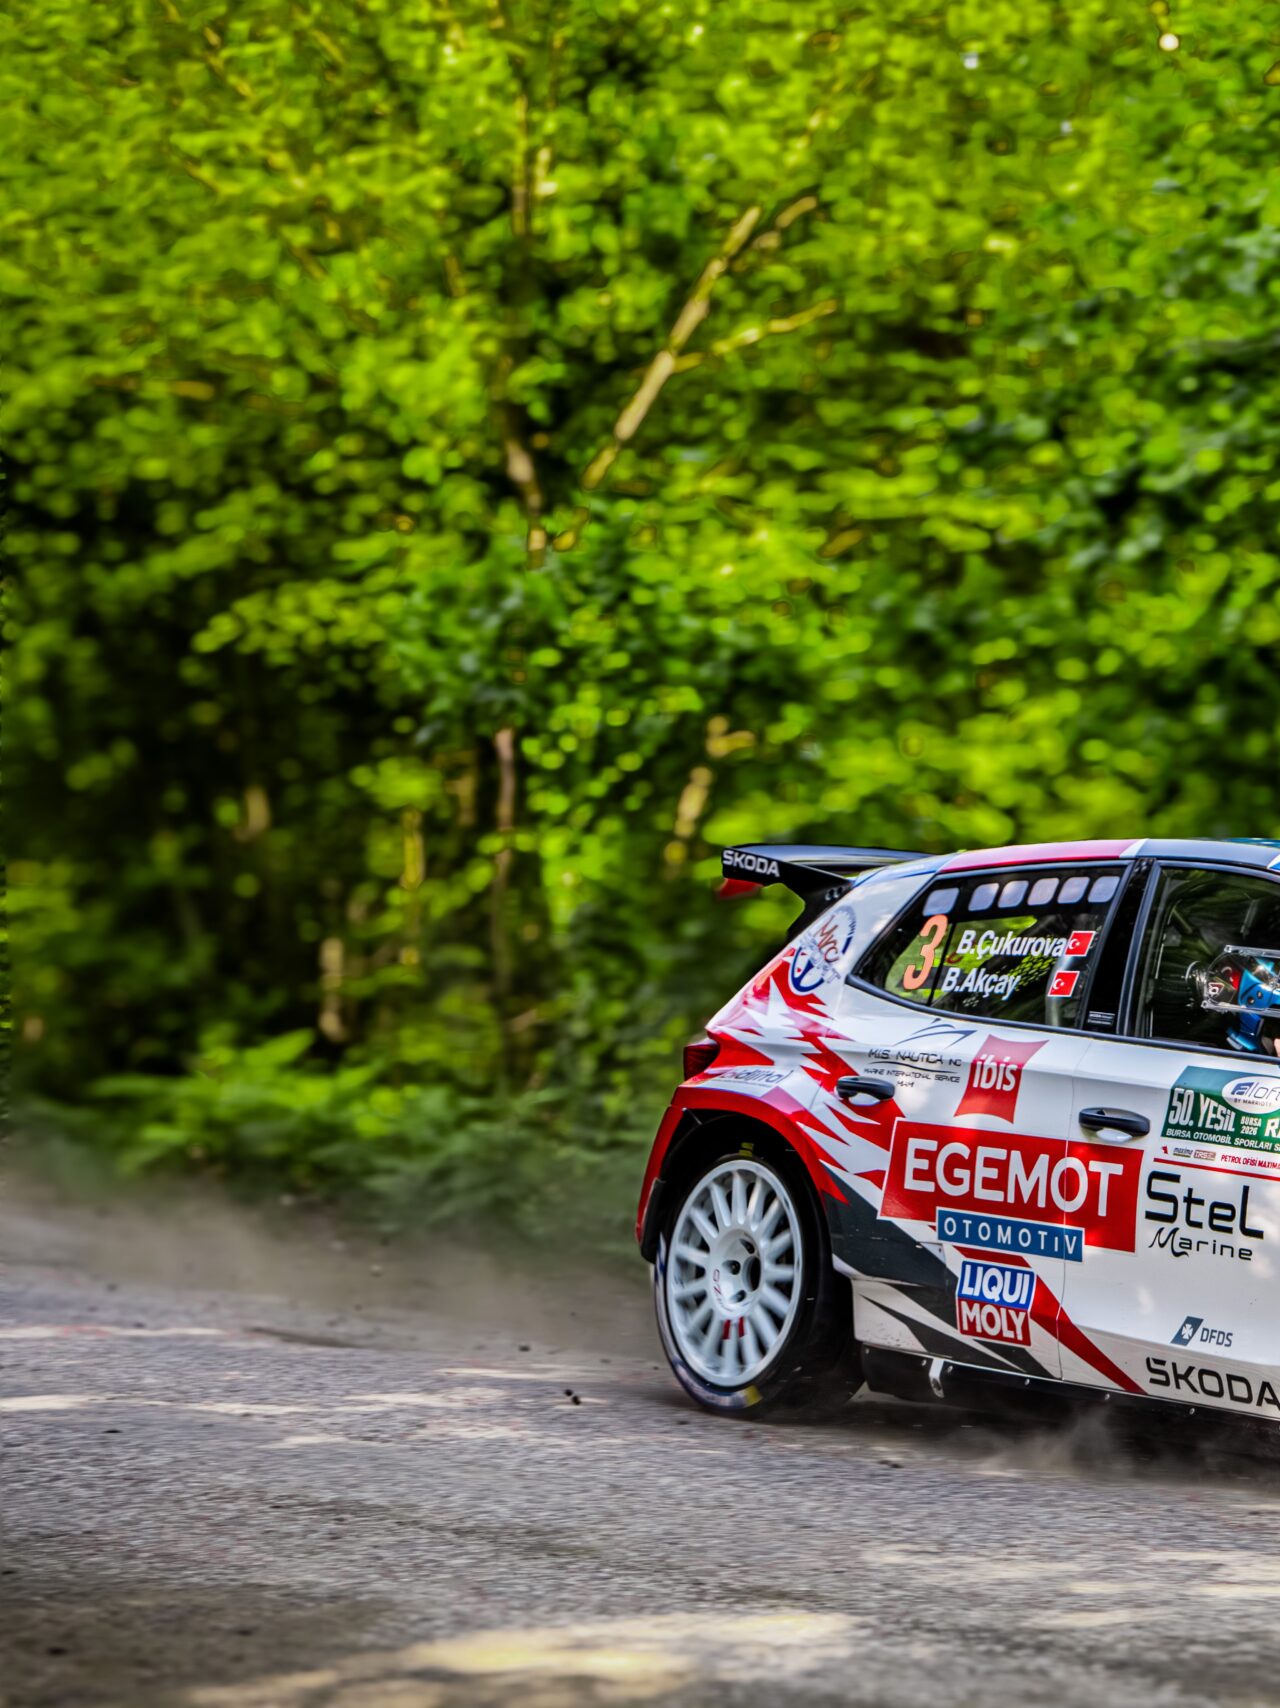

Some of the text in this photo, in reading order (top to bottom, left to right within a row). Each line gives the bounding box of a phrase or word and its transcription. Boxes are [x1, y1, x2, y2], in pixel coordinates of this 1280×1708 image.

[902, 913, 949, 991] 3
[956, 929, 1067, 960] B.Çukurova
[941, 966, 1022, 1001] B.Akçay
[896, 1051, 944, 1065] NAUTICA
[972, 1054, 1019, 1092] ibis
[1167, 1087, 1195, 1127] 50.
[1165, 1127, 1191, 1139] BURSA
[1233, 1137, 1273, 1151] SPORLARI
[903, 1137, 1124, 1217] EGEMOT
[1221, 1154, 1242, 1165] PETROL
[1148, 1226, 1254, 1261] Marine
[961, 1264, 1031, 1305] LIQUI
[960, 1300, 1027, 1341] MOLY
[1200, 1328, 1234, 1347] DFDS
